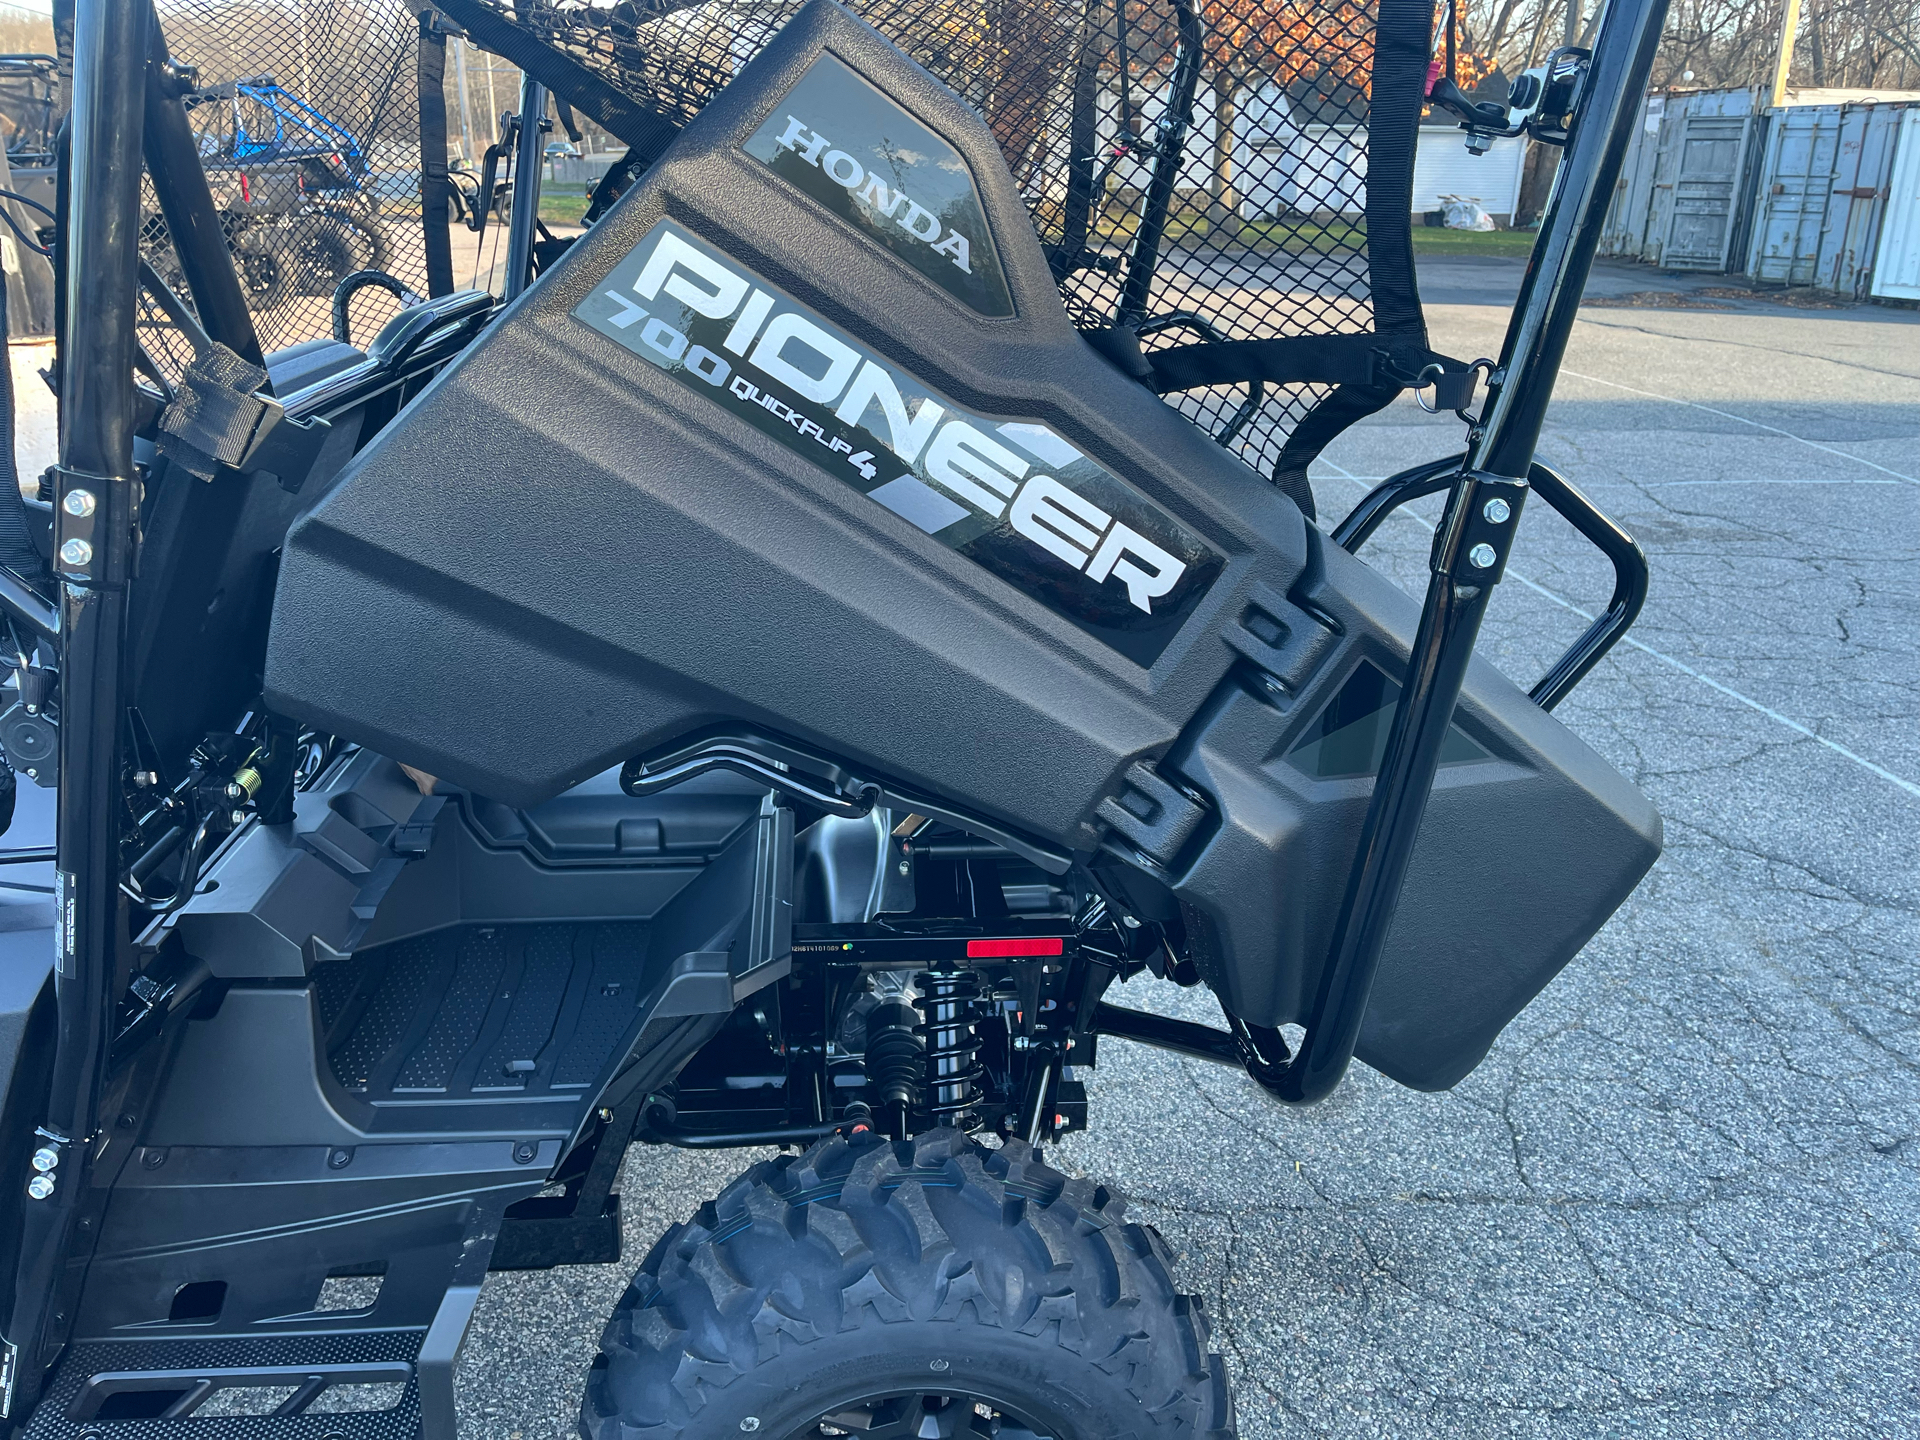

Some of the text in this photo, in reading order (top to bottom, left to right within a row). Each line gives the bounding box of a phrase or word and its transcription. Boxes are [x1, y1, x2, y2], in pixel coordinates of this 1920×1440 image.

[775, 114, 973, 275] HONDA
[604, 290, 732, 387] 700
[632, 231, 1187, 615] PIONEER
